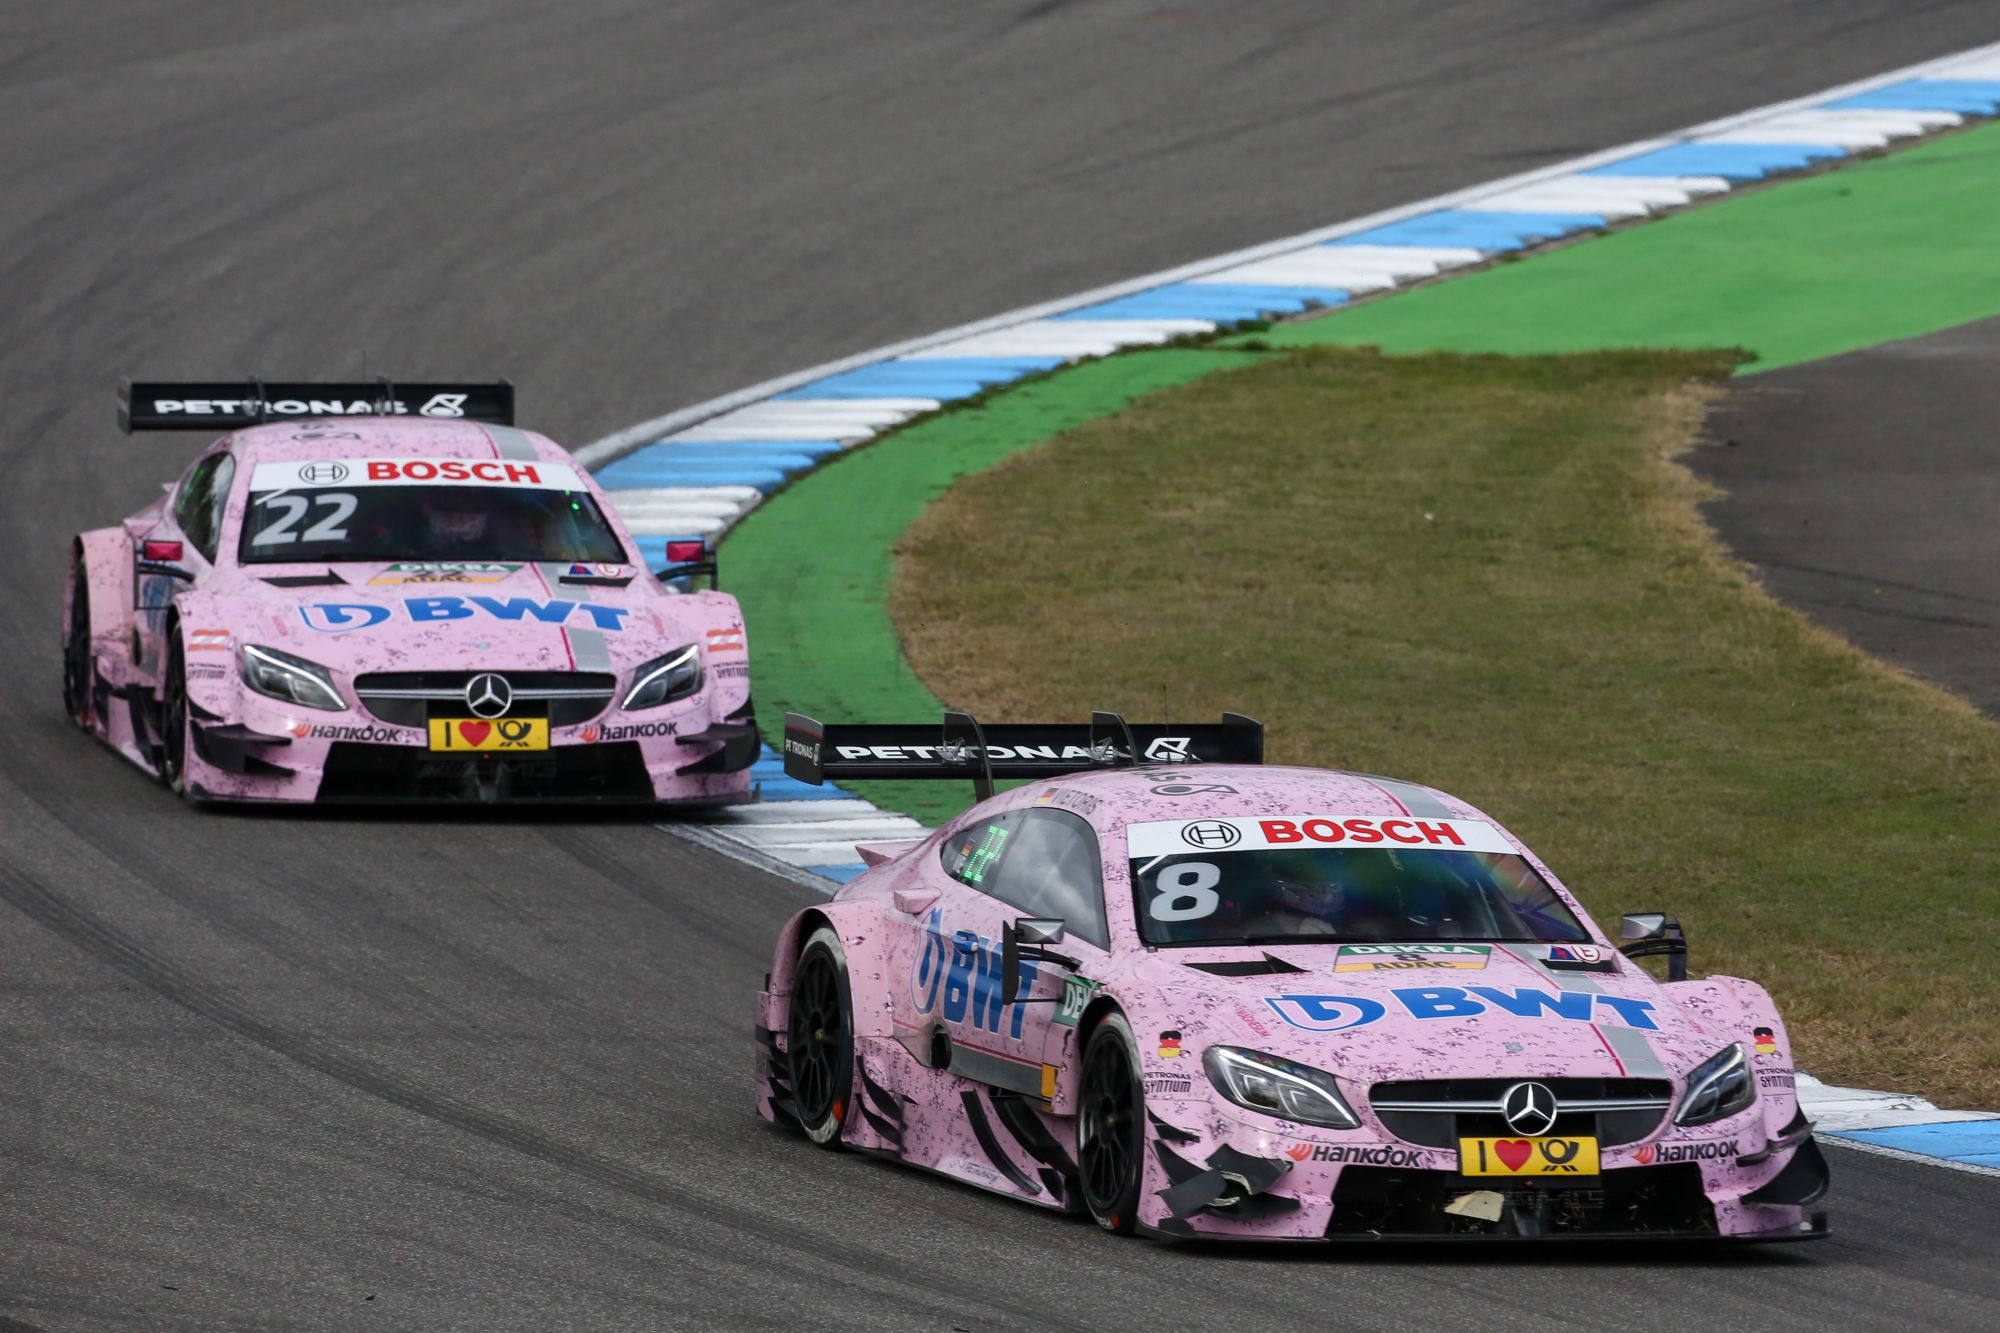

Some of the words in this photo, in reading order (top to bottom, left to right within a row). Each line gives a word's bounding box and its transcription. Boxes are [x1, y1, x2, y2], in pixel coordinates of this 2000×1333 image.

[367, 461, 542, 483] BOSCH
[251, 493, 358, 546] 22
[403, 596, 630, 631] BWT
[1258, 818, 1466, 846] BOSCH
[1150, 862, 1221, 922] 8
[1348, 945, 1482, 954] DEKRA
[1372, 961, 1457, 970] ADAC
[1388, 985, 1662, 1031] BWT
